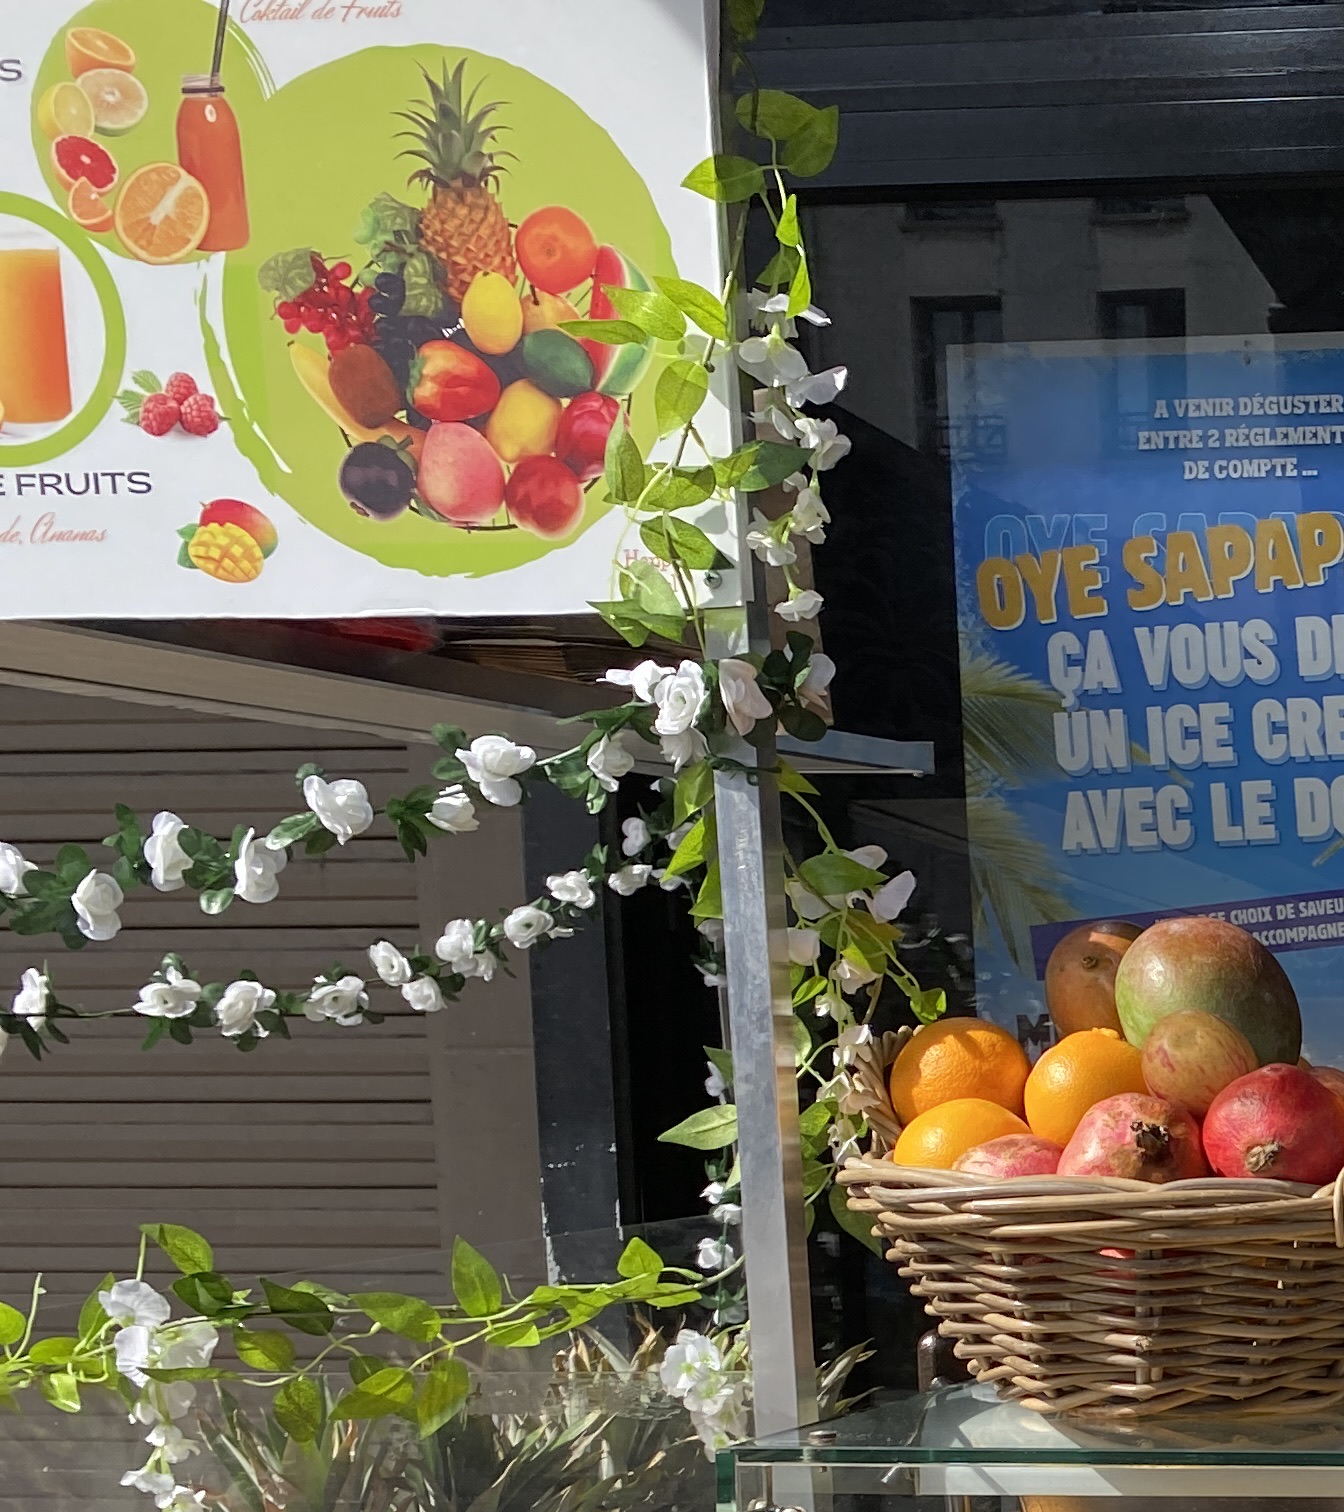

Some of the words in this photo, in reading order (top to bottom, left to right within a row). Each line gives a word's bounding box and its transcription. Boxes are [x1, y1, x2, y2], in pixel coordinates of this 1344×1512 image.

[1174, 397, 1235, 418] VENIR
[1239, 392, 1344, 416] DÉGUSTER
[1138, 429, 1204, 450] ENTRE
[1208, 430, 1220, 448] 2
[1183, 460, 1210, 480] DE
[1214, 457, 1298, 480] COMPTE
[15, 471, 153, 497] FRUITS
[30, 511, 108, 544] Ananas
[976, 545, 1110, 632] OYE
[1047, 629, 1123, 708] ÇA
[1134, 618, 1281, 691] VOUS
[1053, 708, 1129, 778] UN
[1146, 702, 1239, 770] ICE
[1062, 784, 1195, 854] AVEC
[1210, 779, 1281, 849] LE
[1230, 905, 1273, 925] CHOIX
[1276, 903, 1296, 920] DE
